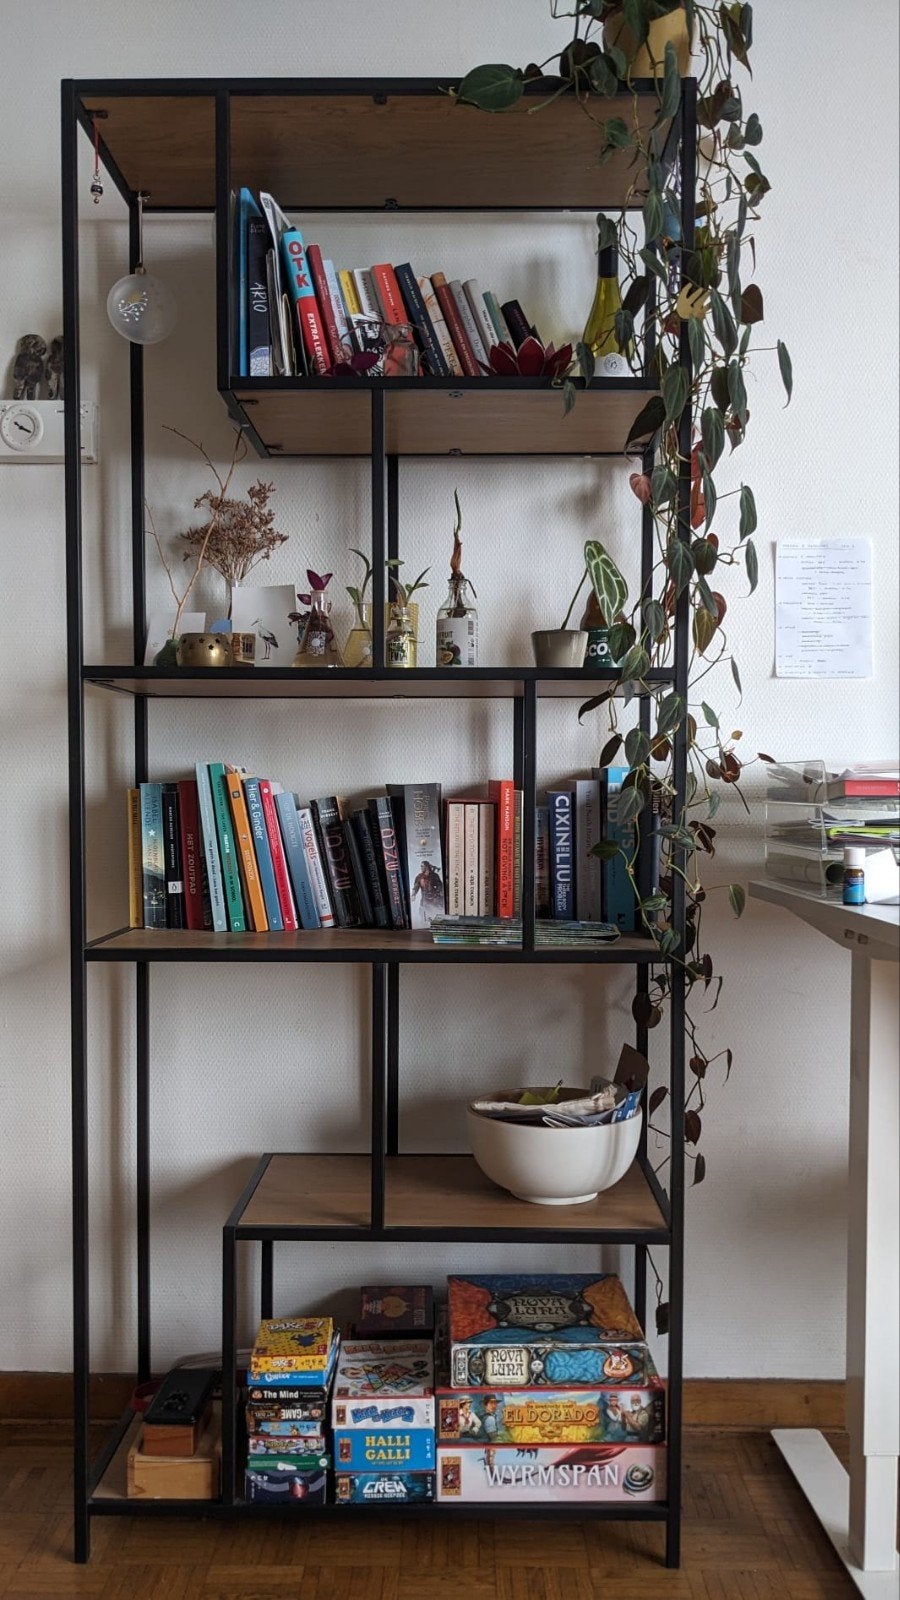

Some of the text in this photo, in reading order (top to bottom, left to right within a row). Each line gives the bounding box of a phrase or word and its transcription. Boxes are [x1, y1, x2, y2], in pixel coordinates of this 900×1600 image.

[288, 241, 310, 288] OTK
[250, 282, 268, 312] ARLO
[307, 312, 318, 342] EXTRA
[248, 783, 266, 840] Hier & Ginder
[556, 795, 570, 846] CIXIN
[302, 829, 319, 860] Vogels
[536, 837, 544, 870] HYPERION
[188, 854, 196, 894] ZOUTPAD
[556, 854, 570, 882] LIU
[512, 1298, 568, 1316] NOVA LUNA
[491, 1350, 524, 1362] NOVA
[491, 1363, 524, 1376] LUNA
[280, 1390, 299, 1398] Mind
[281, 1409, 302, 1420] GAME
[504, 1408, 598, 1422] EL DORADO
[365, 1436, 410, 1446] HALLI
[366, 1448, 410, 1460] GALLI
[486, 1464, 619, 1487] WYRMSPAN
[363, 1482, 407, 1493] CREW
